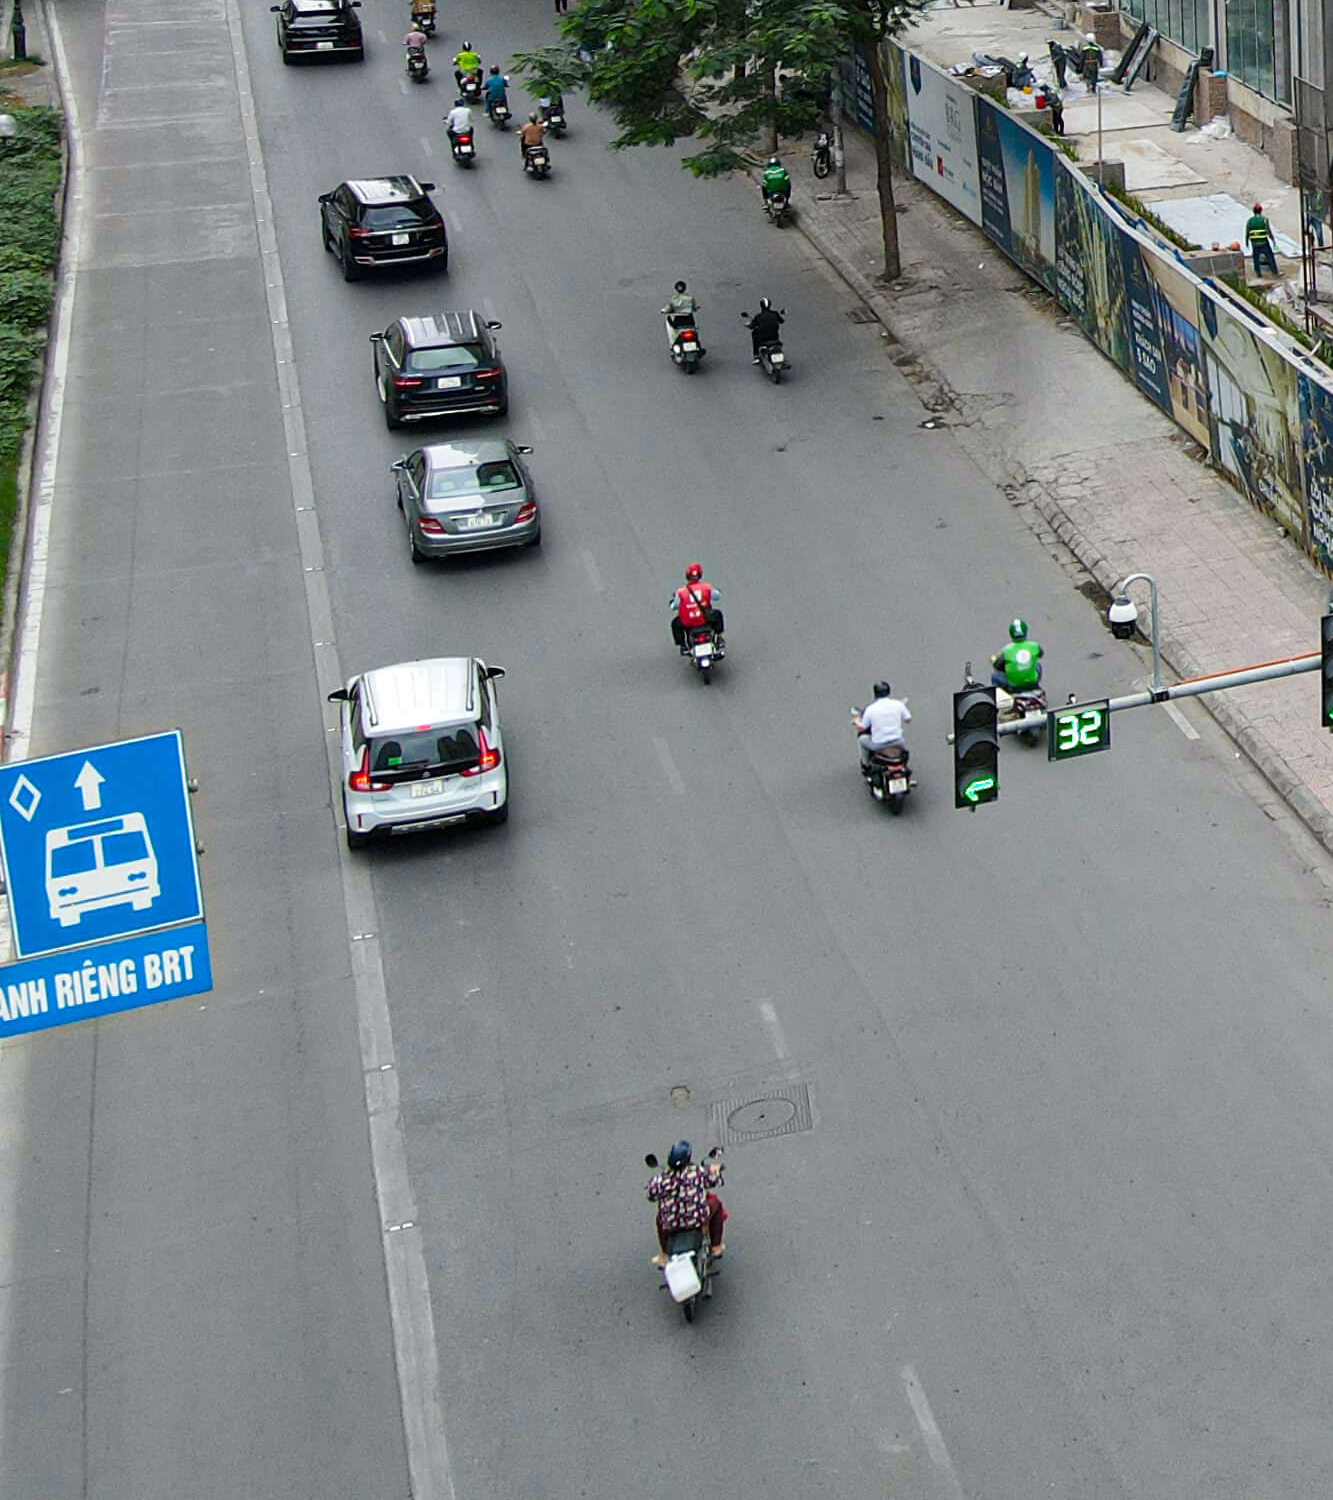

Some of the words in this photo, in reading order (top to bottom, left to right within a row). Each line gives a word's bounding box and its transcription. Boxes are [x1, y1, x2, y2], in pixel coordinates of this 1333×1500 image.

[1060, 710, 1101, 751] 32
[54, 959, 137, 1010] RIÊNG
[144, 945, 195, 990] BRT
